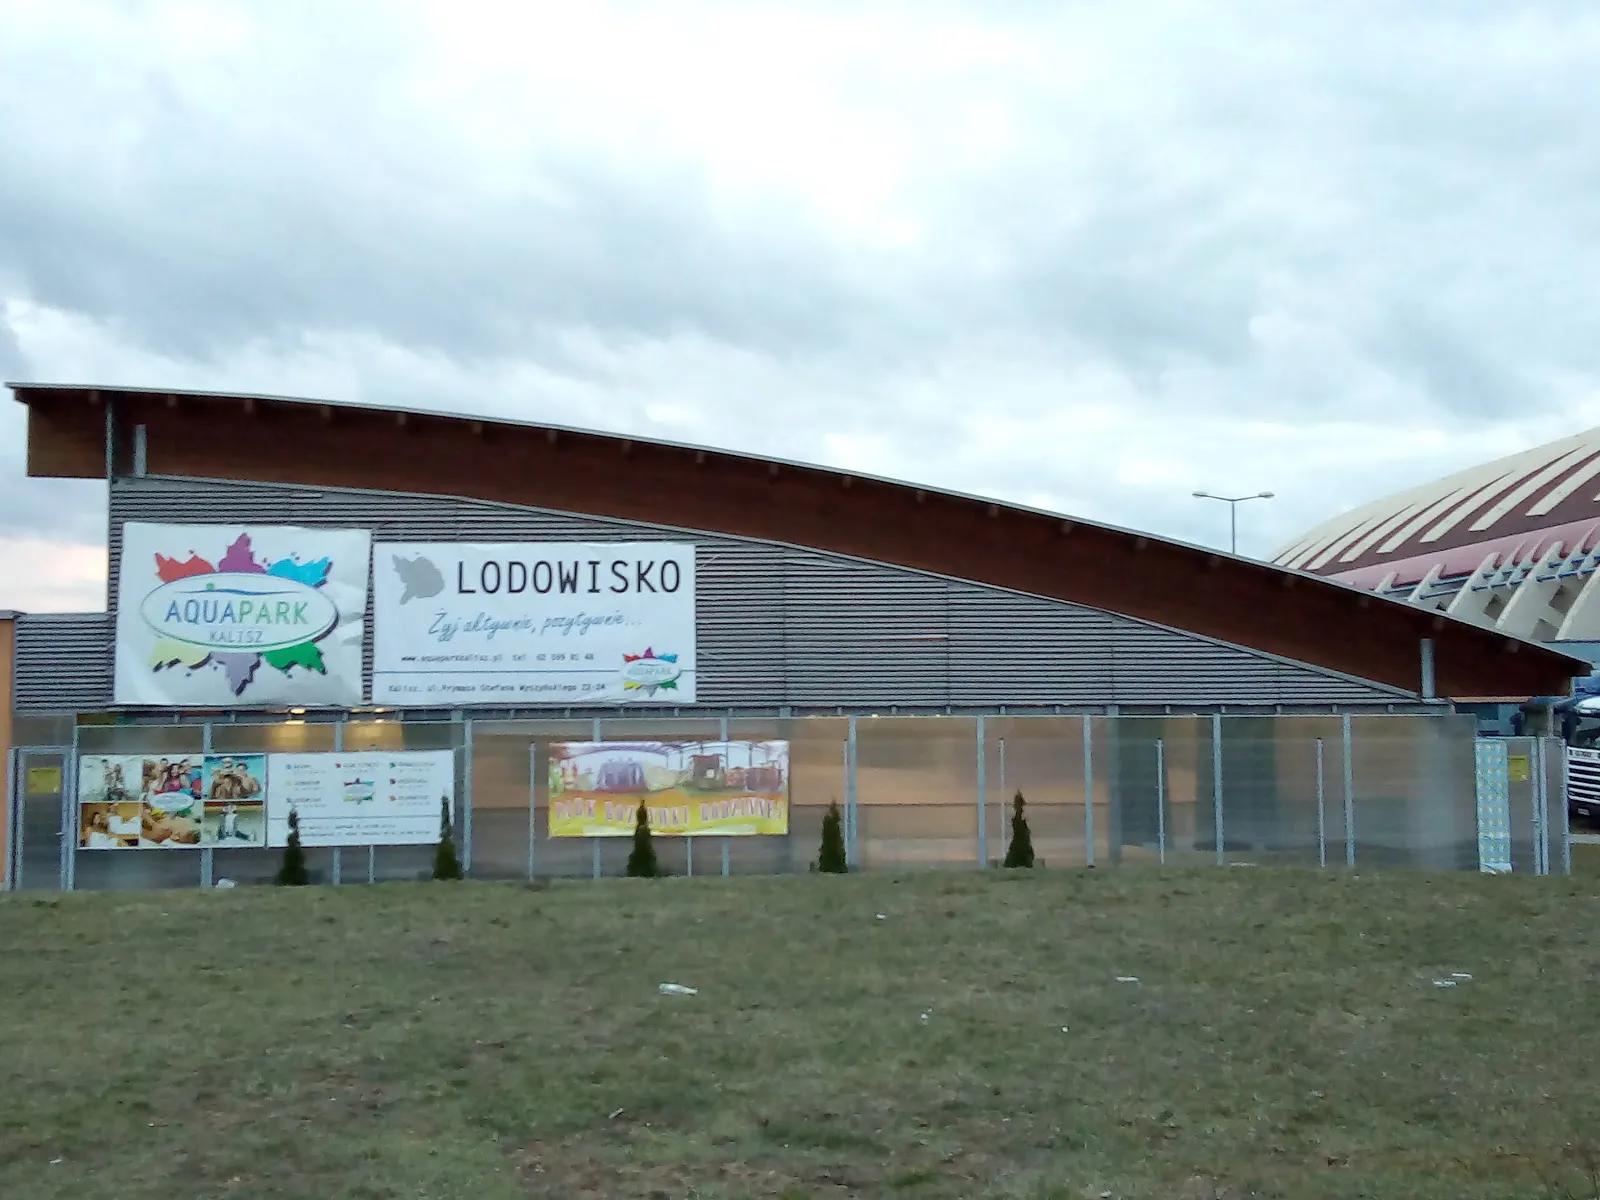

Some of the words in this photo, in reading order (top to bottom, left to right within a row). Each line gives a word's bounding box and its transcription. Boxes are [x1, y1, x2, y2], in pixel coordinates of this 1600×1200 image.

[457, 558, 681, 594] LODOWISKO
[164, 598, 309, 626] AQUAPARK
[428, 608, 461, 643] Żyj
[208, 630, 264, 644] KALISZ
